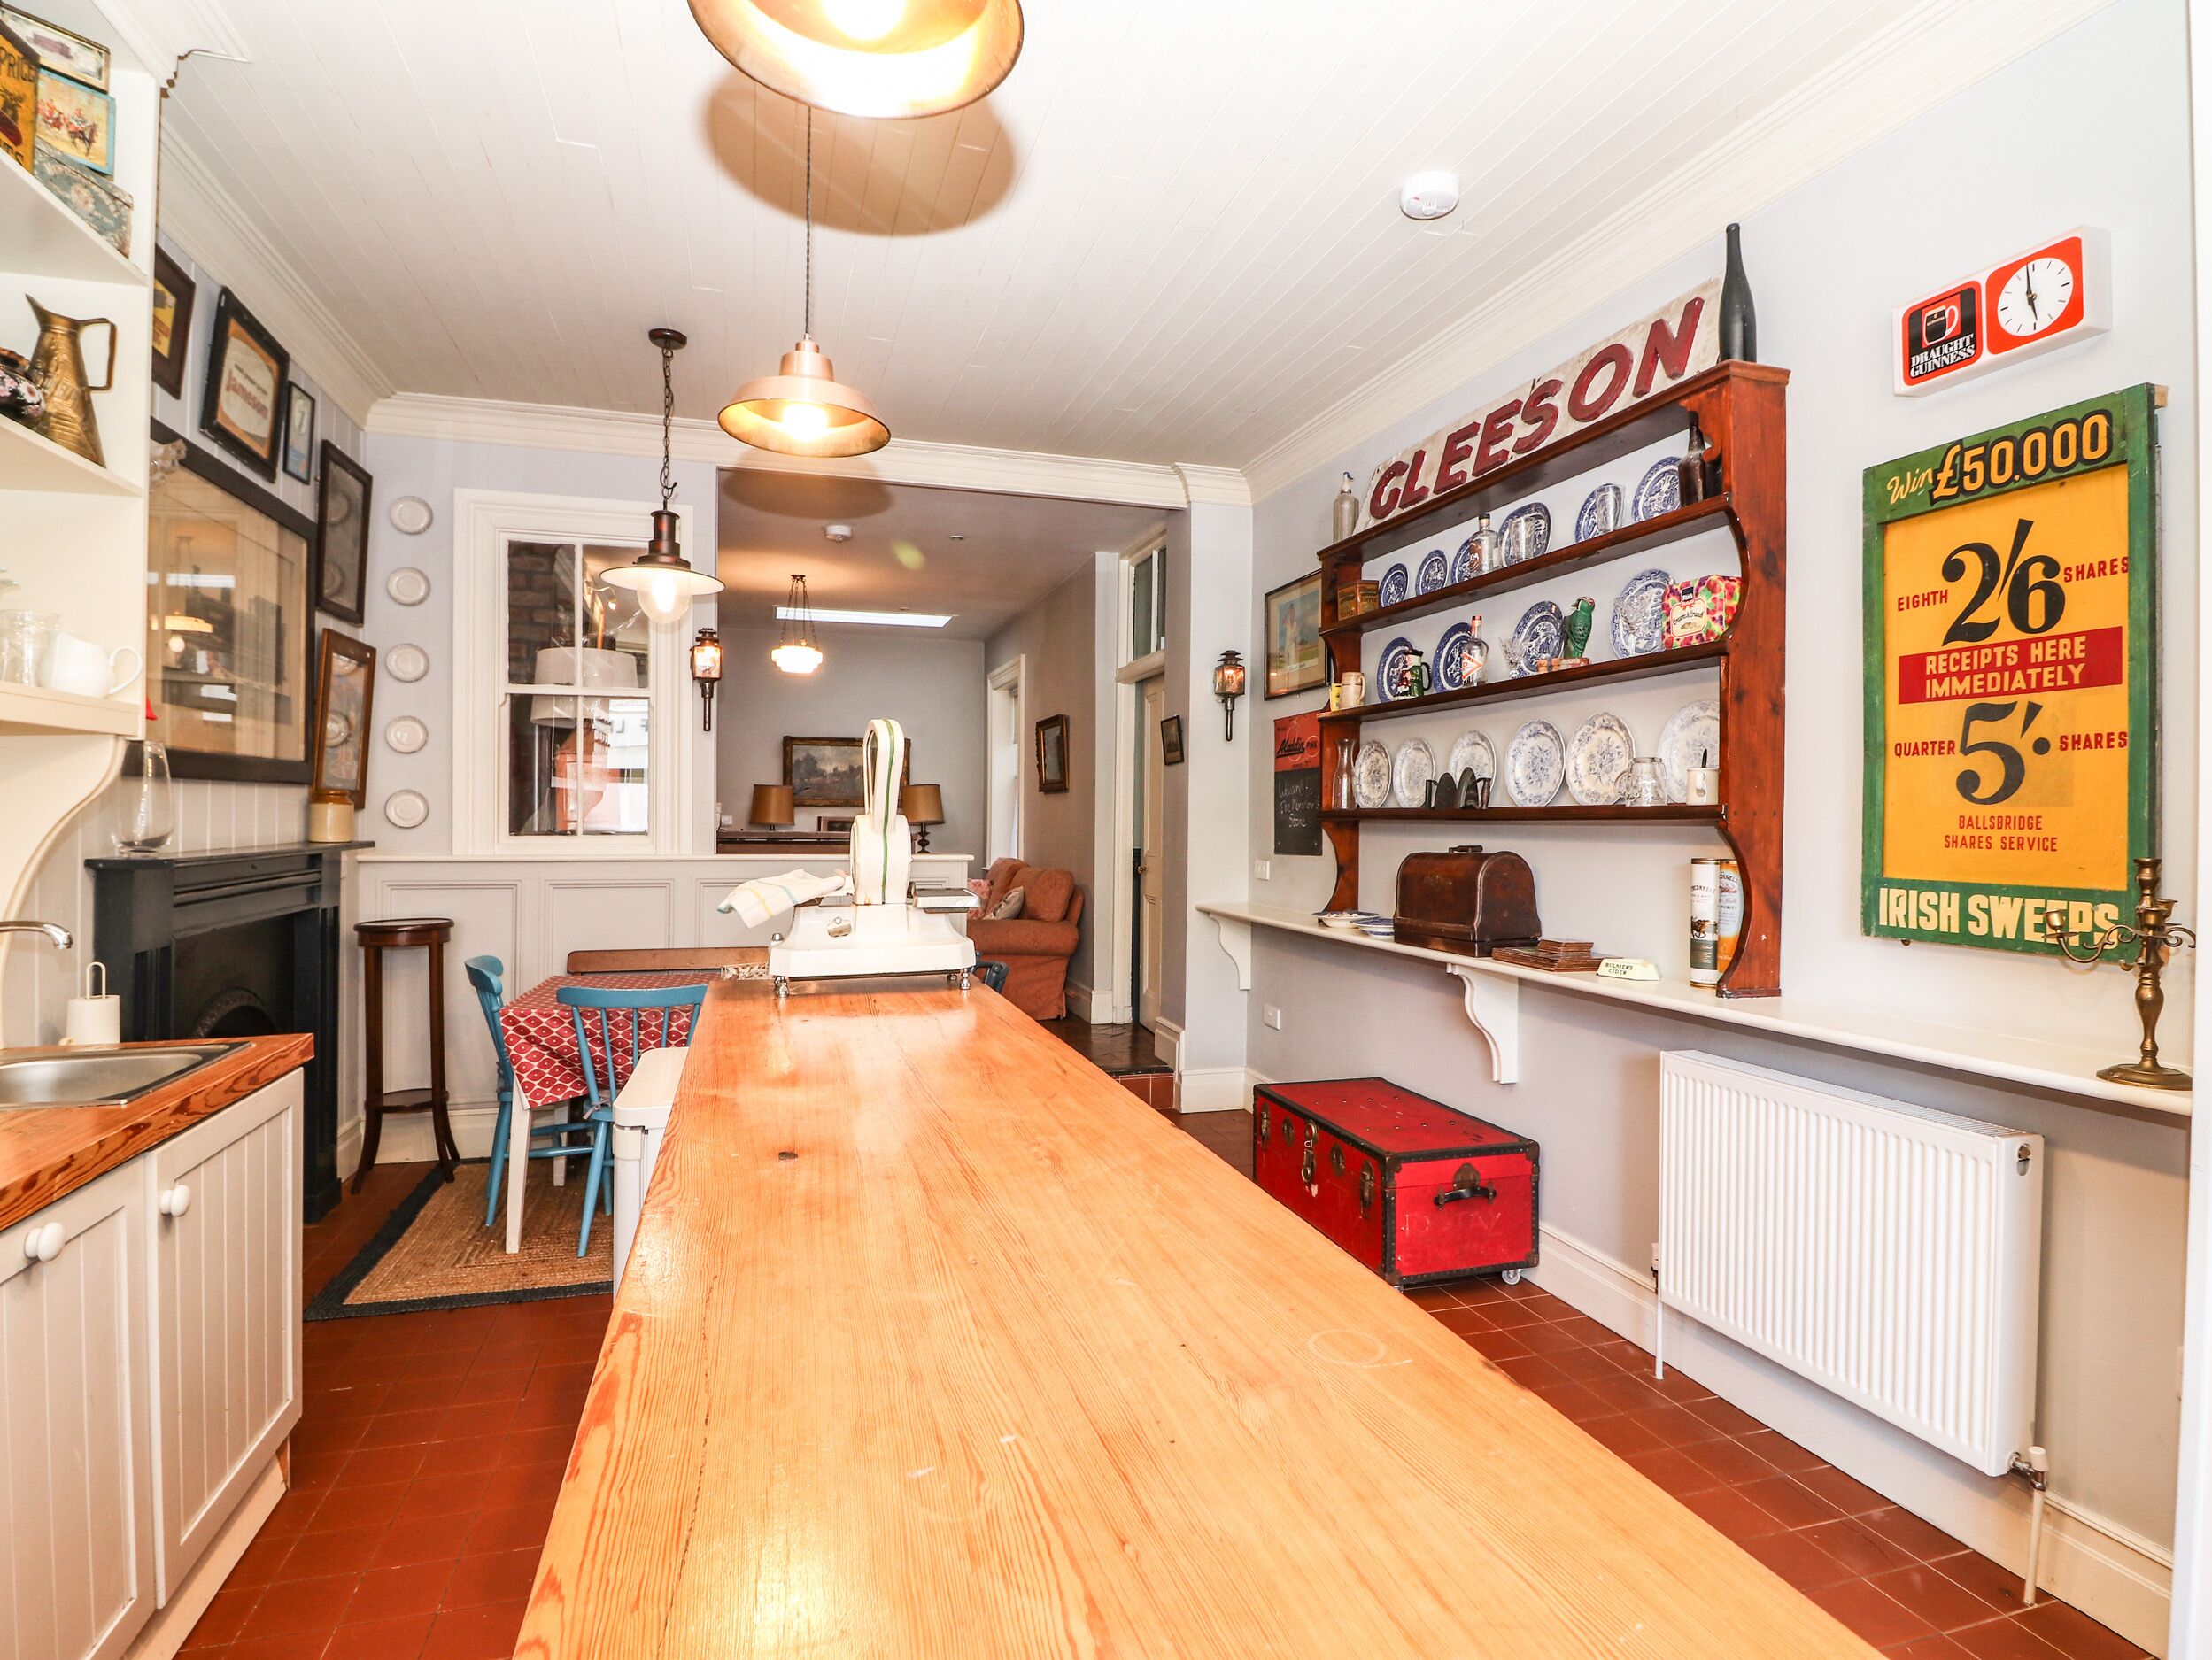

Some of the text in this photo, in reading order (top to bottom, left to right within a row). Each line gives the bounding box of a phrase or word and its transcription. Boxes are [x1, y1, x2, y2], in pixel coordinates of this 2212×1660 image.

[1909, 344, 1976, 378] GUINNESS
[1910, 333, 1975, 367] DRAUGHT
[1369, 296, 1705, 521] GLEESON
[1886, 467, 1933, 505] Win
[2063, 556, 2129, 583] SHARES
[1897, 589, 1948, 612] EIGHTH
[1925, 635, 2086, 676] RECEIPTS HERE
[1925, 662, 2086, 699] IMMEDIATELY
[1894, 739, 1956, 759] QUARTER
[2059, 731, 2128, 753] SHARES
[1958, 815, 2043, 831] BALLSBRIDGE
[1944, 835, 2058, 852] SHARES SERVICE
[1878, 887, 1960, 934] IRISH
